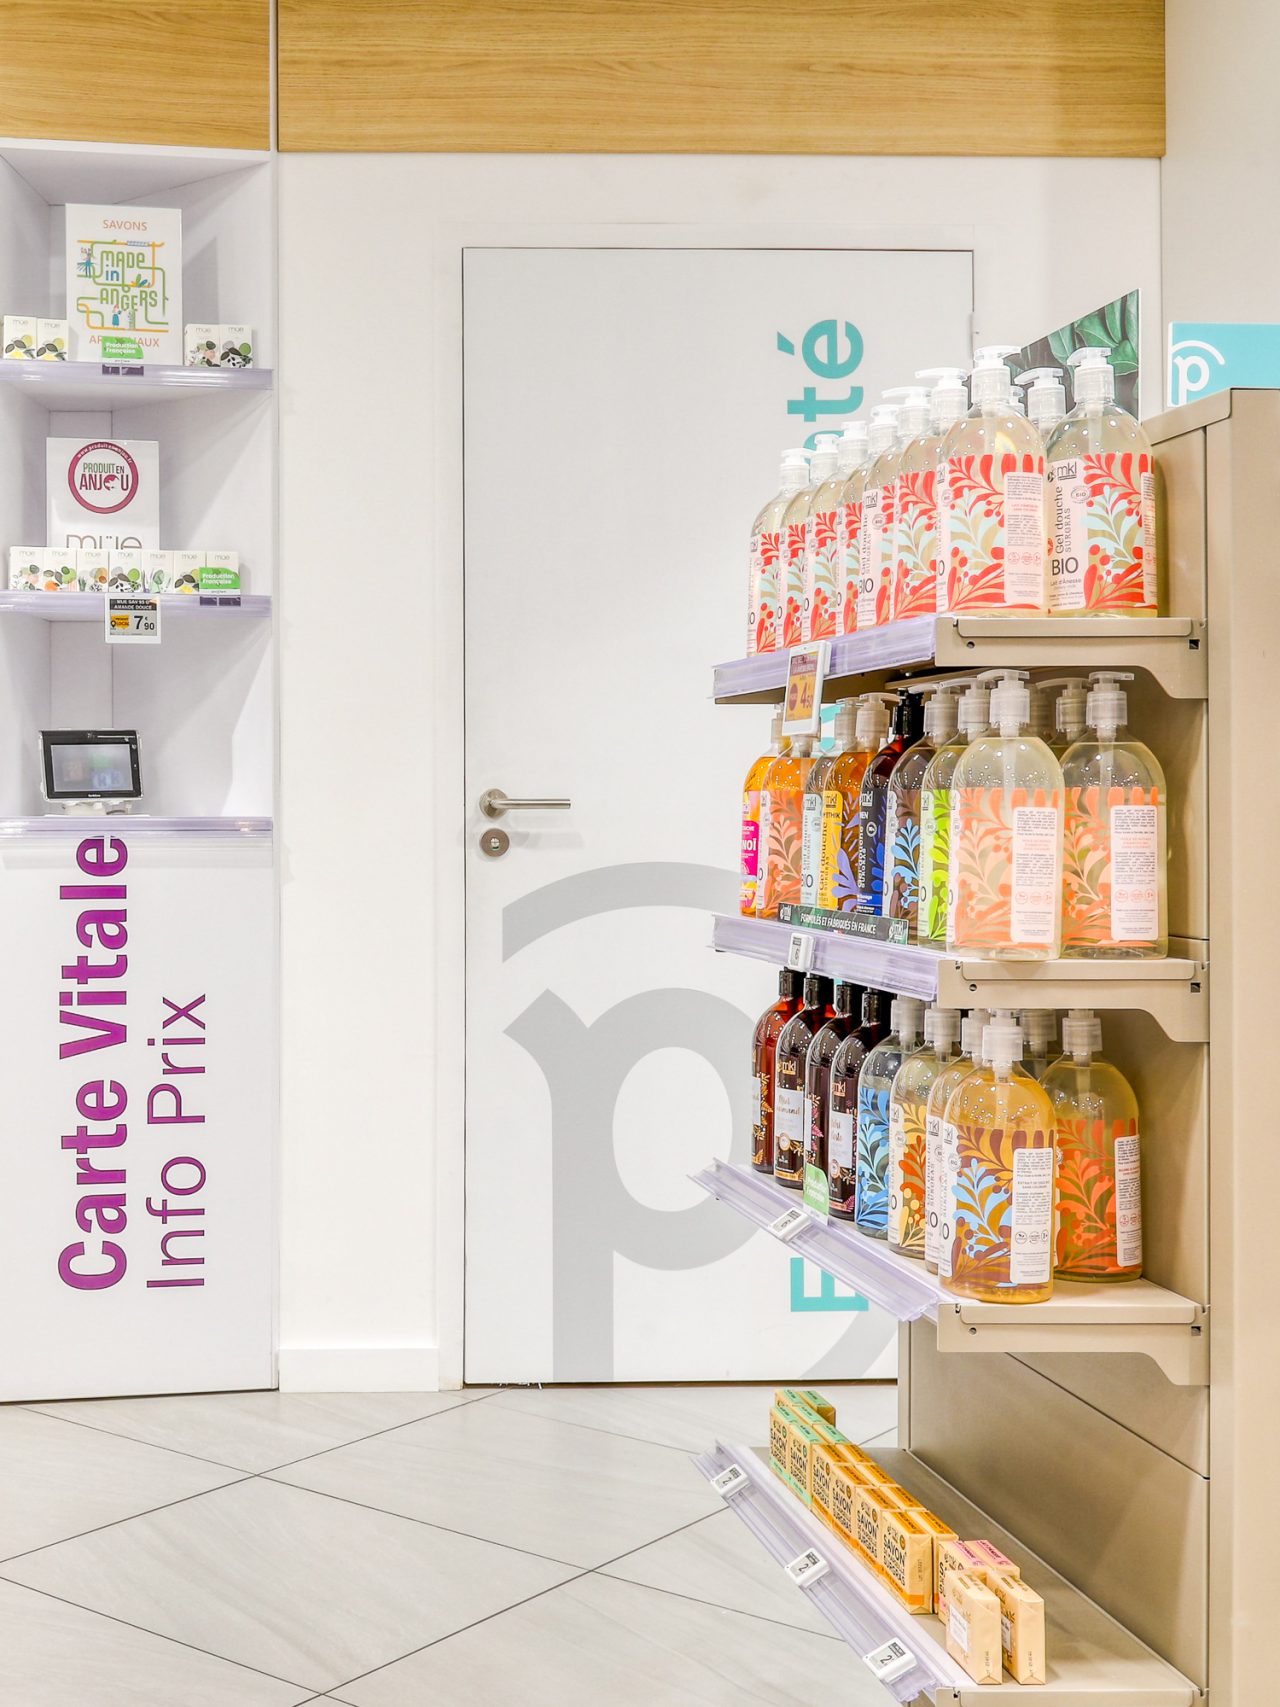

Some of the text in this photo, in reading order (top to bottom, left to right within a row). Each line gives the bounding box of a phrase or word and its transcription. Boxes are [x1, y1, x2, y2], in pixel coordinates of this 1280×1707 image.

[102, 219, 148, 232] SAVONS
[82, 462, 125, 474] PRODUIT EN
[1056, 462, 1077, 478] mkl
[1054, 486, 1064, 555] Gel douche
[1064, 507, 1072, 553] SURGRAS
[1051, 556, 1079, 576] BIO
[858, 922, 877, 934] FRANCE
[58, 834, 128, 1290] Carte Vitale
[146, 993, 207, 1289] Info Prix
[883, 1533, 906, 1566] SAVON
